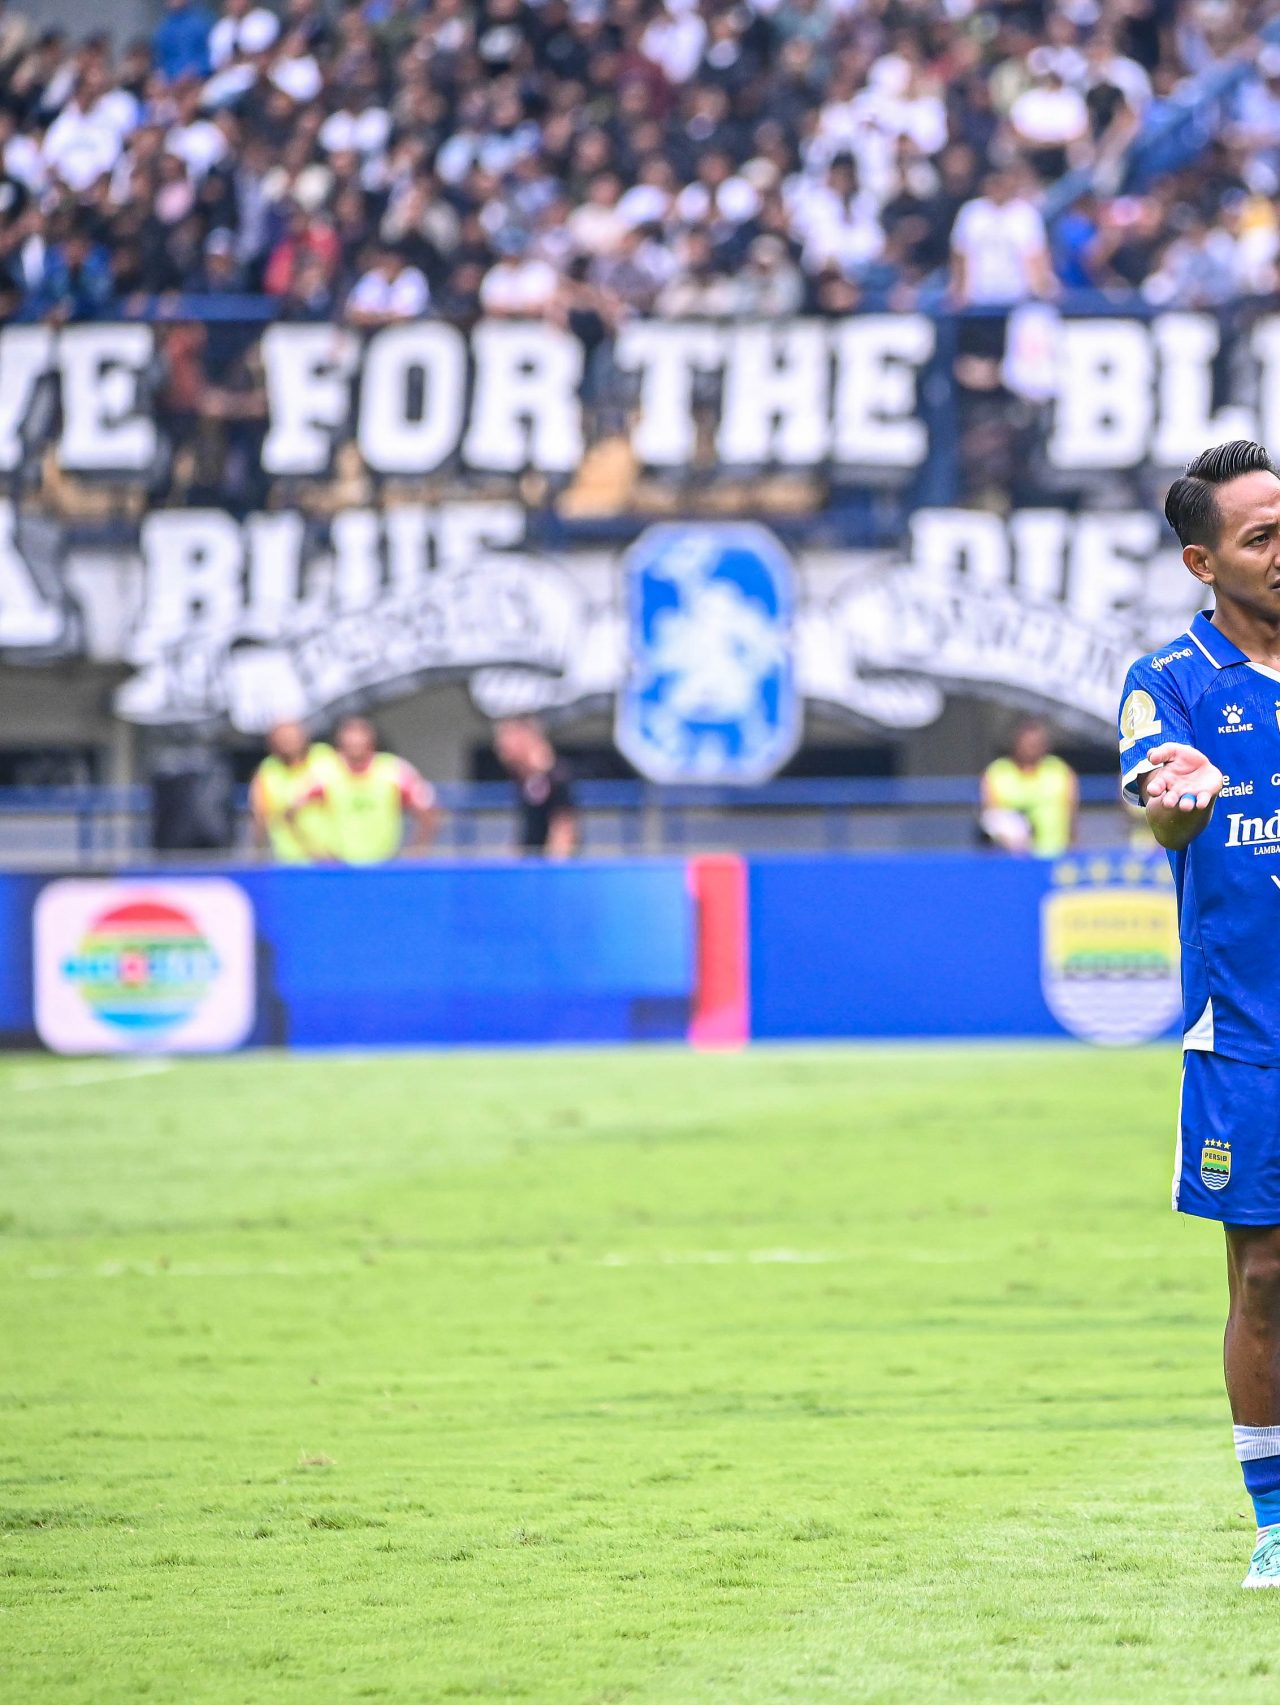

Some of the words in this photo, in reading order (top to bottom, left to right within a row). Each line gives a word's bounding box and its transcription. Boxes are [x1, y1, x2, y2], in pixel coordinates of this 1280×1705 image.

[261, 321, 585, 475] FOR
[615, 313, 934, 468] THE
[1218, 723, 1254, 734] KELME
[1204, 1151, 1228, 1163] PERSIB
